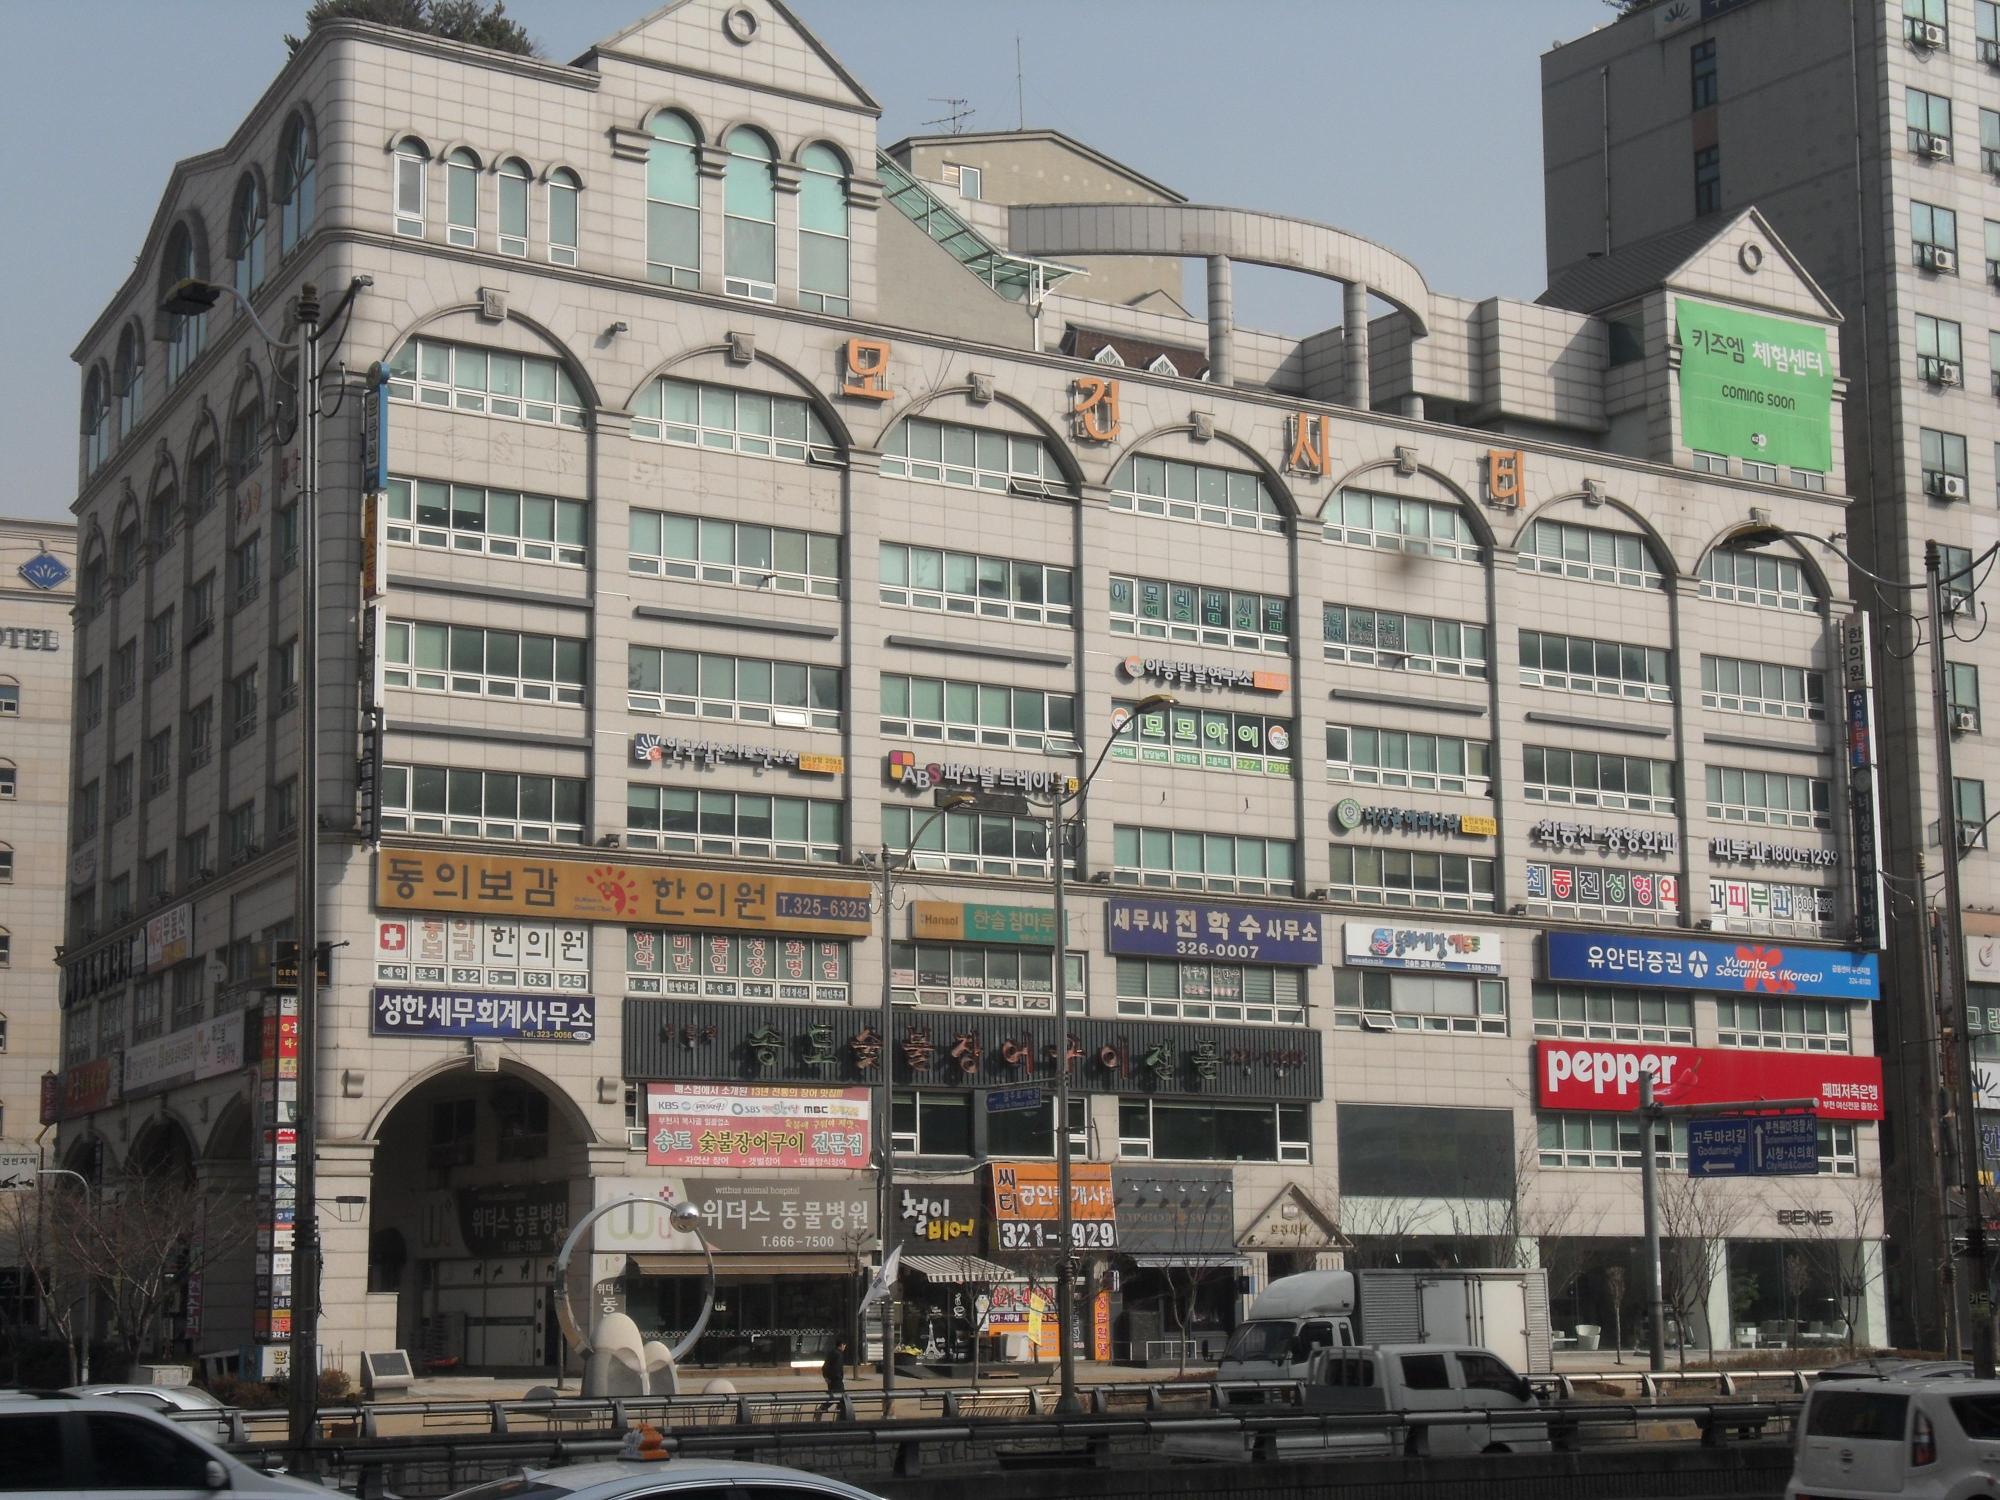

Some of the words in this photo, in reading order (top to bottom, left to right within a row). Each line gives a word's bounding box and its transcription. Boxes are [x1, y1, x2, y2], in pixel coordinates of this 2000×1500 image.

[1692, 329, 1745, 364] 키즈엠
[1752, 341, 1824, 377] 체험센터
[1112, 583, 1283, 621] 아모레퍼시픽
[1145, 658, 1254, 688] 아동발달연구소
[1142, 714, 1259, 749] 모모아이
[902, 763, 943, 789] ABS
[944, 763, 995, 788] 퍼스널
[1538, 820, 1597, 845] 최동진
[1603, 824, 1679, 855] 성형외과
[1714, 837, 1765, 864] 피부과
[1771, 844, 1839, 866] 1800-1299
[386, 857, 558, 908] 동의보감
[652, 876, 766, 921] 한의원
[1527, 866, 1600, 901] 최동진
[1728, 885, 1792, 916] 피부과
[779, 895, 867, 919] T.325-6325
[925, 915, 958, 926] Hansol
[973, 909, 1006, 930] 한솔
[1113, 908, 1168, 933] 세무사
[1175, 909, 1261, 941] 전학수
[1266, 919, 1318, 942] 사무소
[490, 926, 585, 962] 한의원
[633, 931, 655, 971] 한약
[672, 934, 693, 973] 비만
[710, 935, 729, 974] 불임
[747, 938, 766, 977] 성장
[1176, 940, 1259, 959] 326-0007
[382, 965, 408, 980] 예약
[415, 968, 439, 981] 문의
[785, 940, 805, 978] 화병
[820, 943, 839, 980] 비염
[1587, 946, 1683, 975] 유안타증권
[1724, 956, 1767, 970] Yuanta
[1715, 966, 1777, 980] Securities
[1779, 970, 1823, 983] (Korea)
[743, 985, 772, 997] 소아과
[750, 1022, 839, 1067] 송도
[1547, 1050, 1678, 1096] pepper
[658, 1101, 679, 1110] KBS
[750, 1087, 769, 1098] 13년
[1822, 1082, 1879, 1100] 페퍼저축은행
[744, 1105, 761, 1114] SBS
[654, 1130, 693, 1152] 송도
[699, 1128, 805, 1156] 숯불장어구이
[811, 1132, 863, 1157] 전문점
[1691, 1129, 1747, 1145] 고두마리길
[715, 1186, 742, 1195] withus
[743, 1186, 769, 1195] animal
[770, 1186, 801, 1197] hospital
[1019, 1184, 1106, 1207] 공인개사
[472, 1206, 510, 1239] 위더스
[513, 1201, 567, 1237] 동물병원
[701, 1200, 771, 1231] 위더스
[778, 1200, 869, 1231] 동물병원
[927, 1219, 975, 1241] 비어
[761, 1235, 835, 1248] T.666-7500
[1002, 1222, 1115, 1249] 321-929
[596, 1283, 622, 1296] 위더스
